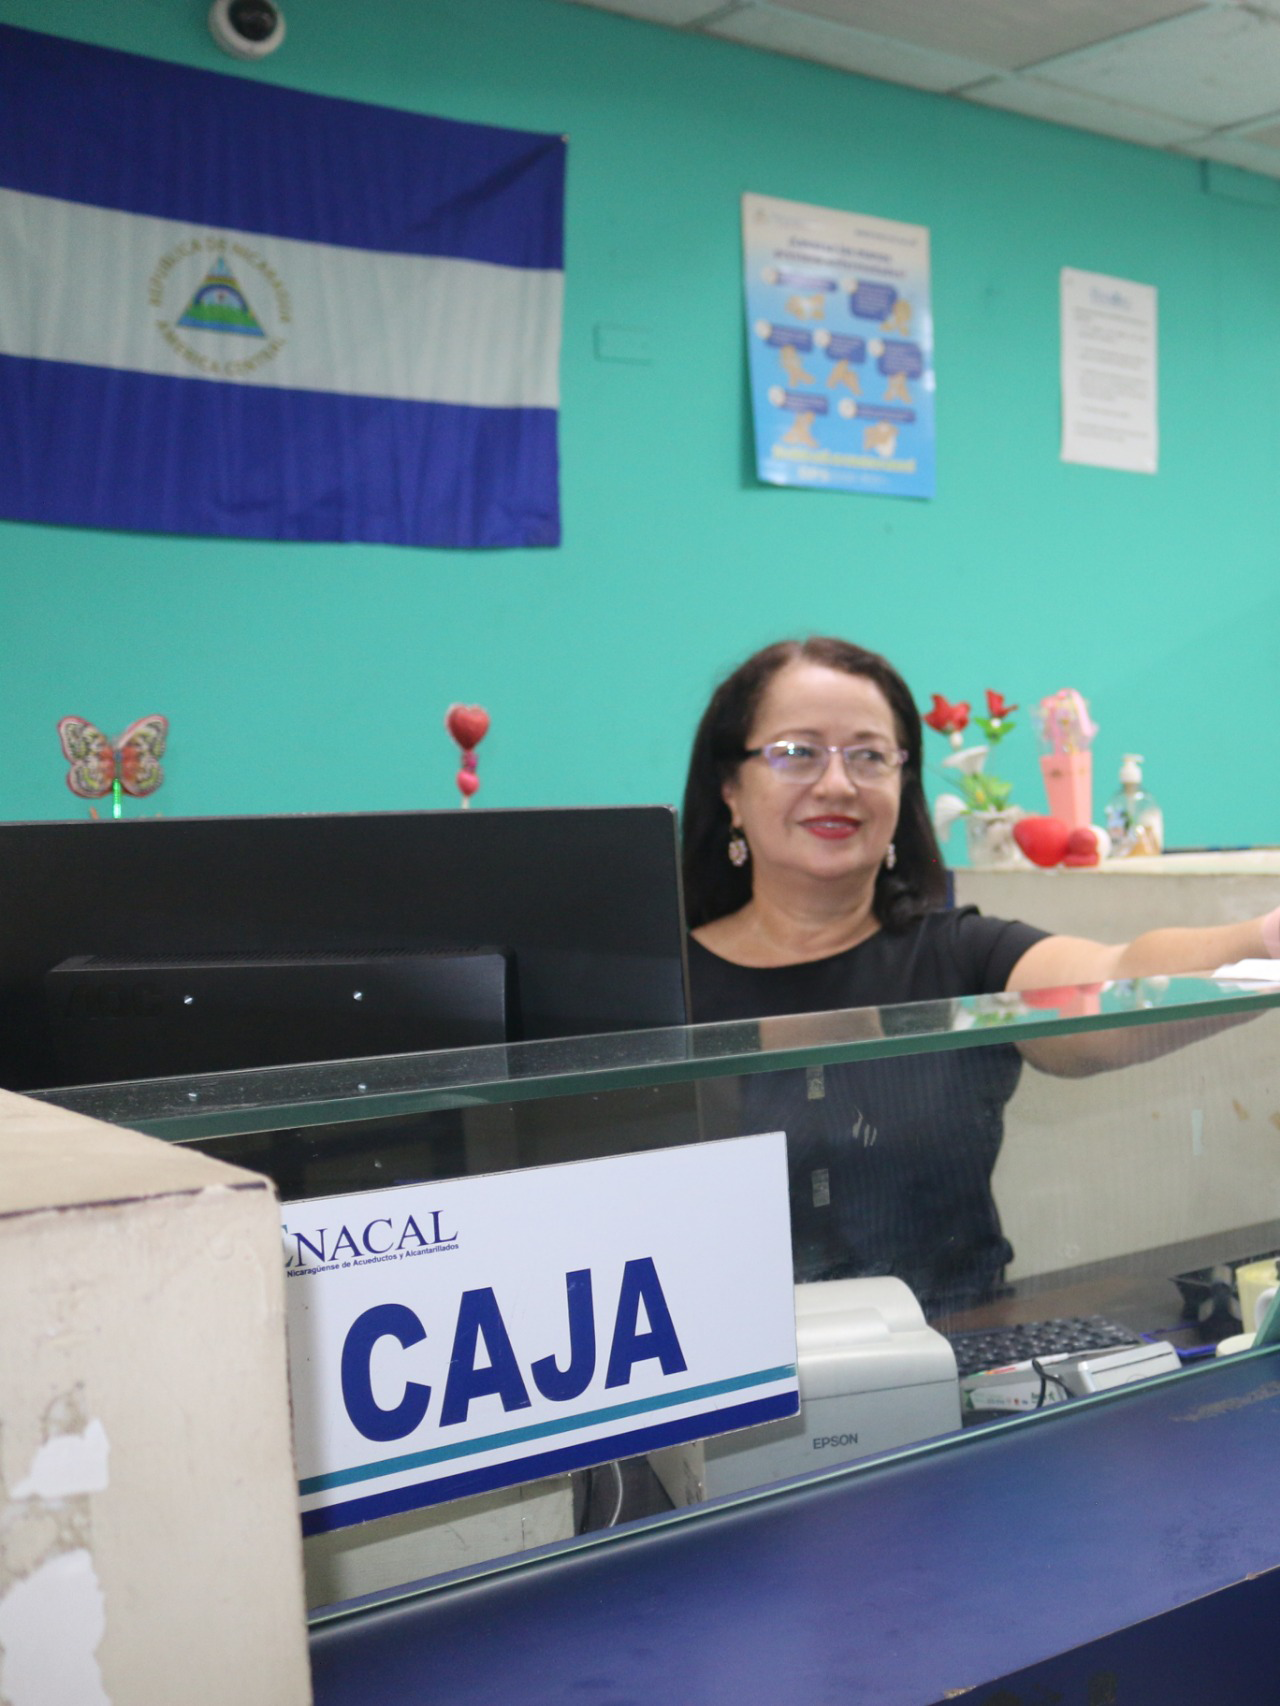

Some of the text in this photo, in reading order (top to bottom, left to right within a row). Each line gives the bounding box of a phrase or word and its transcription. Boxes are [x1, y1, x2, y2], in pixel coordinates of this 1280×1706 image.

[286, 1262, 340, 1278] Nicaragüense
[343, 1260, 351, 1268] de
[352, 1254, 398, 1267] Acueductos
[405, 1243, 460, 1258] Alcantarillados
[341, 1256, 688, 1442] CAJA
[812, 1433, 859, 1450] EPSON
